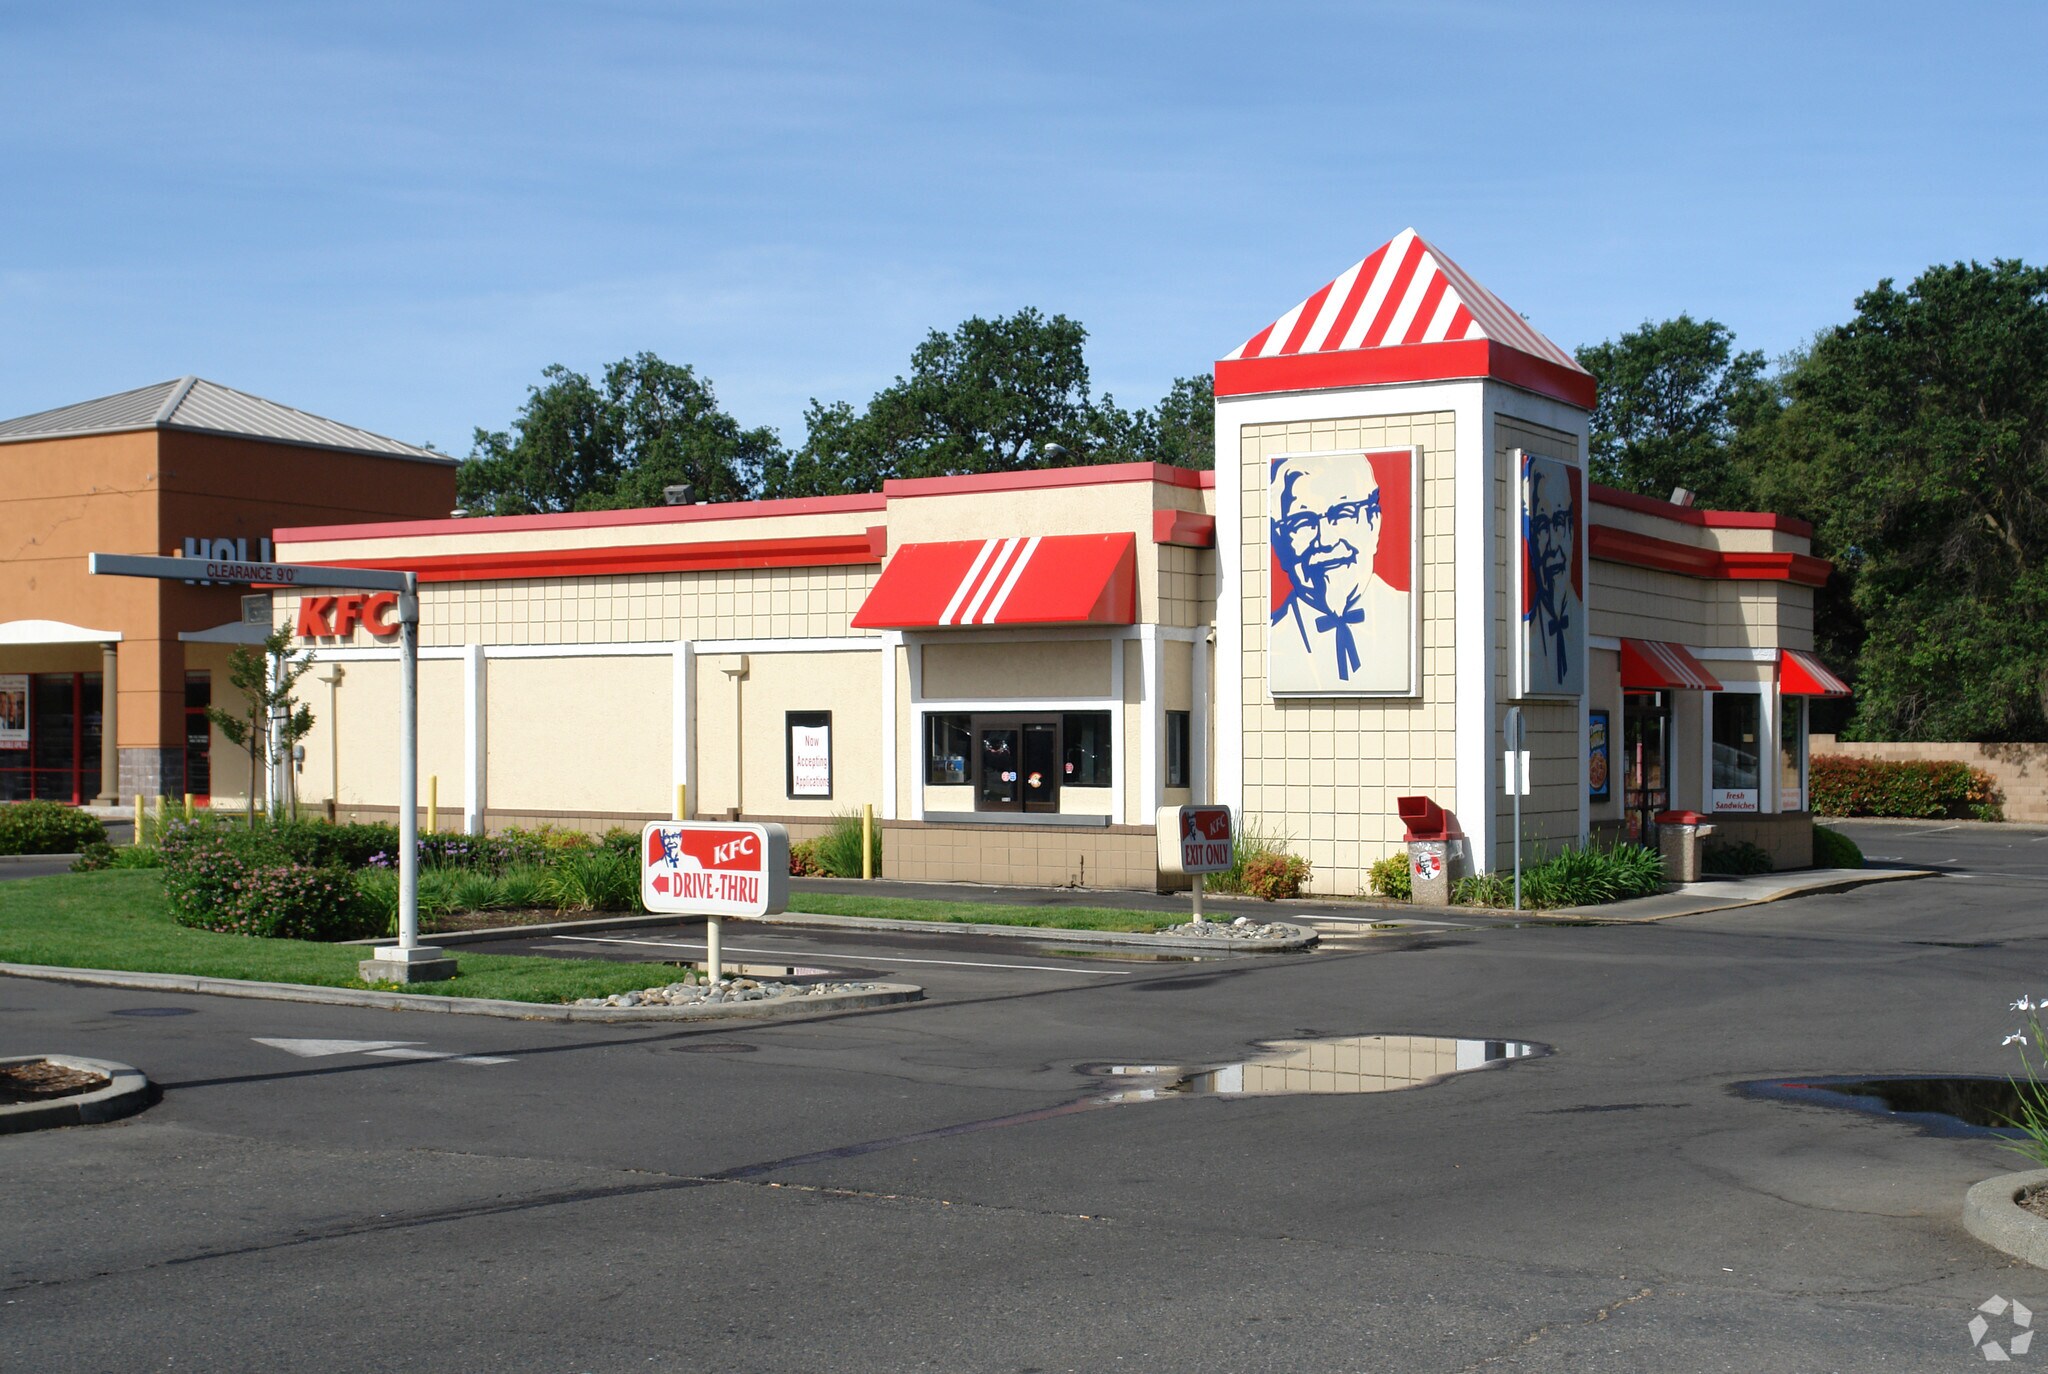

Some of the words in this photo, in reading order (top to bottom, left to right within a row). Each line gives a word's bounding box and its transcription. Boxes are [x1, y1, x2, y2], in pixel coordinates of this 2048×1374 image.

[207, 563, 272, 580] CLEARANCE
[297, 592, 400, 637] KFC
[805, 735, 819, 746] Now
[797, 755, 827, 769] Accepting
[1715, 801, 1755, 810] Sandwiches
[1209, 815, 1226, 835] KFC
[713, 835, 754, 865] KFC
[1185, 844, 1204, 866] EXIT
[1206, 843, 1228, 865] ONLY
[673, 872, 759, 904] DRIVE-THRU
